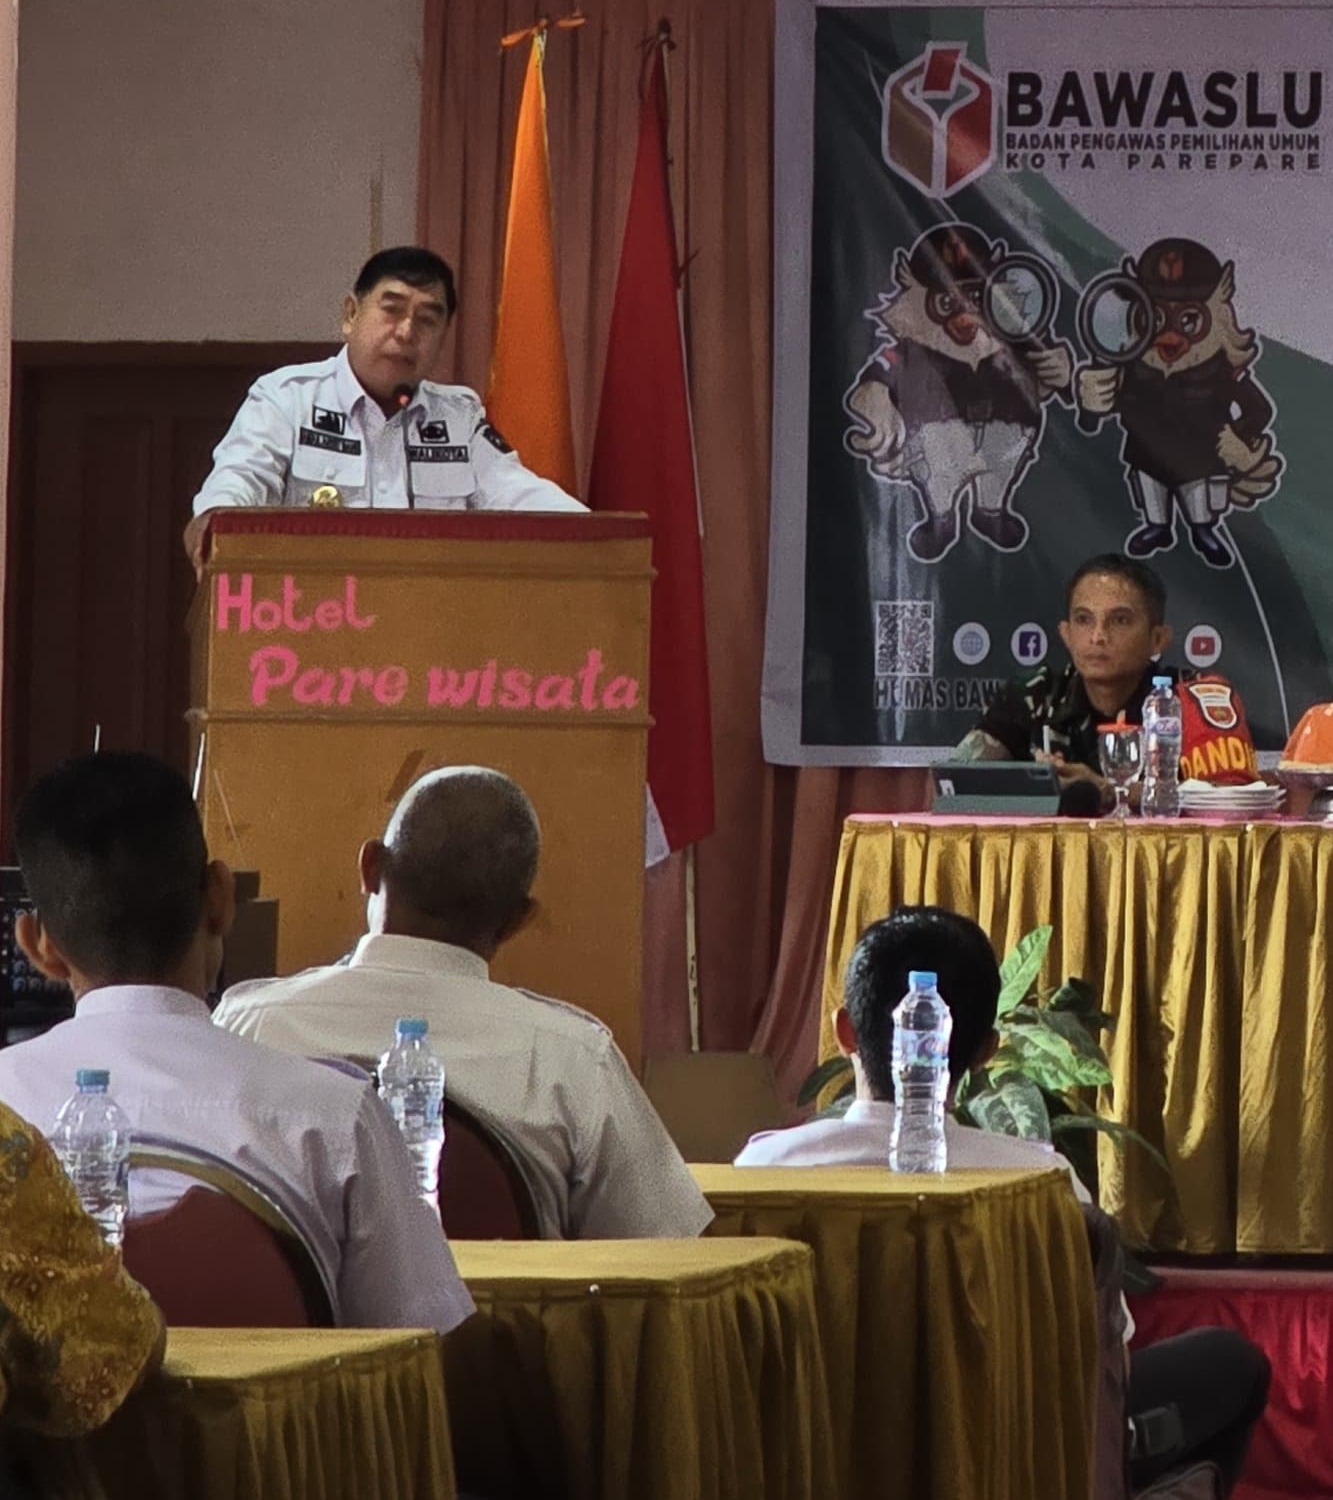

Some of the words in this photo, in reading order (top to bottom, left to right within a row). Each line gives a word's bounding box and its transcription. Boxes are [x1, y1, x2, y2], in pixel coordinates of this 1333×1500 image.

[1006, 70, 1322, 129] BAWASLU
[1006, 133, 1065, 150] BADAN
[1070, 133, 1166, 150] PENGAWAS
[1170, 133, 1264, 150] PEMILIHAN
[1269, 133, 1320, 150] UMUM
[1006, 153, 1095, 170] KOTA
[1128, 153, 1321, 170] PAREPARE
[216, 573, 379, 632] Hotel
[1180, 736, 1258, 779] DANDI
